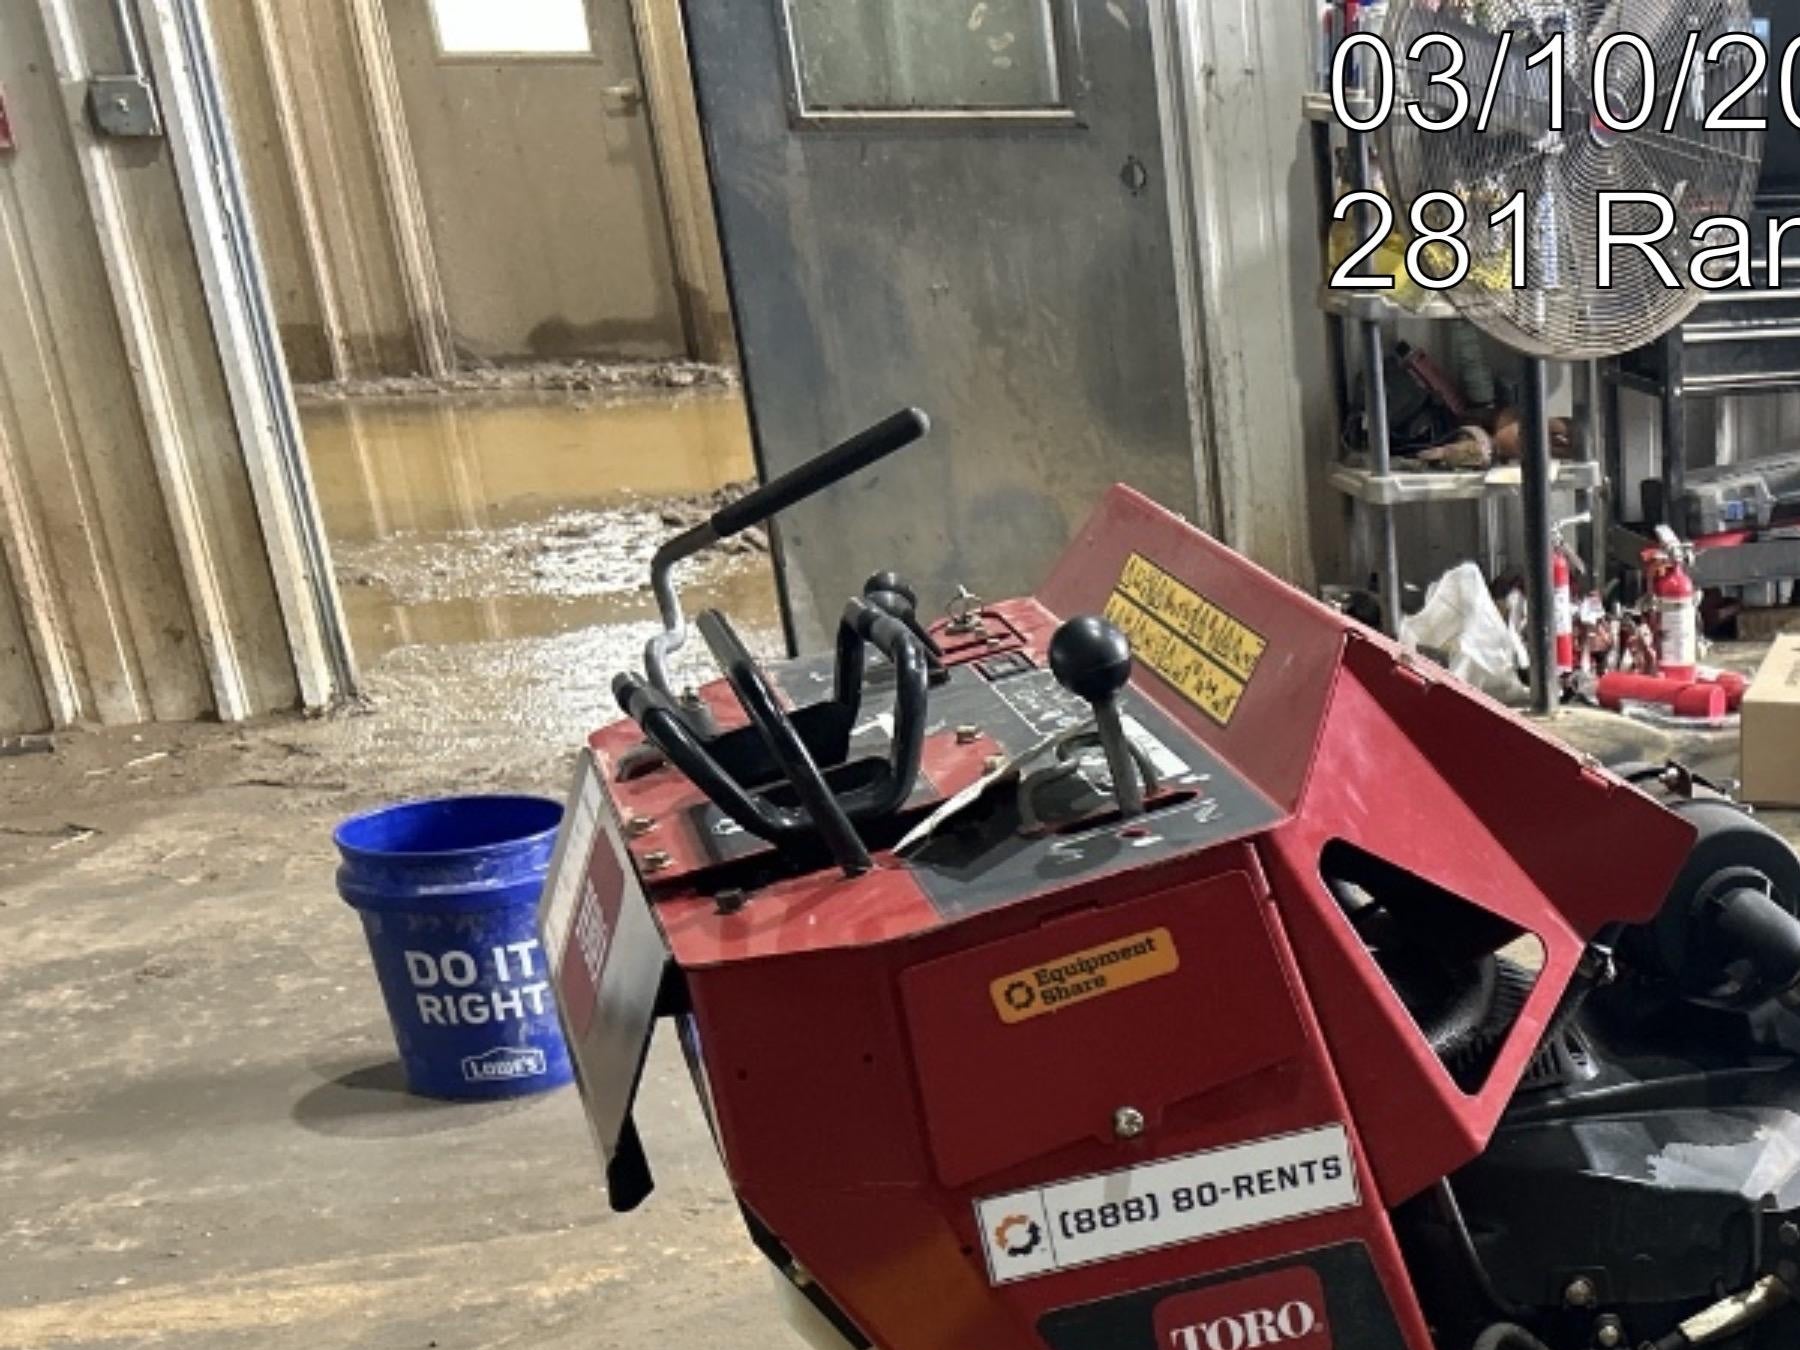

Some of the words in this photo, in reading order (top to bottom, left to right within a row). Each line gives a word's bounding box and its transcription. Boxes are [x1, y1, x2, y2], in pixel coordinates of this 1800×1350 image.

[404, 950, 478, 987] DO
[493, 939, 538, 982] IT
[1034, 937, 1157, 985] Equipment
[416, 982, 549, 1026] RIGHT
[1040, 974, 1108, 1007] Share
[1059, 1192, 1160, 1240] (888)
[1171, 1154, 1343, 1210] 80-RENTS
